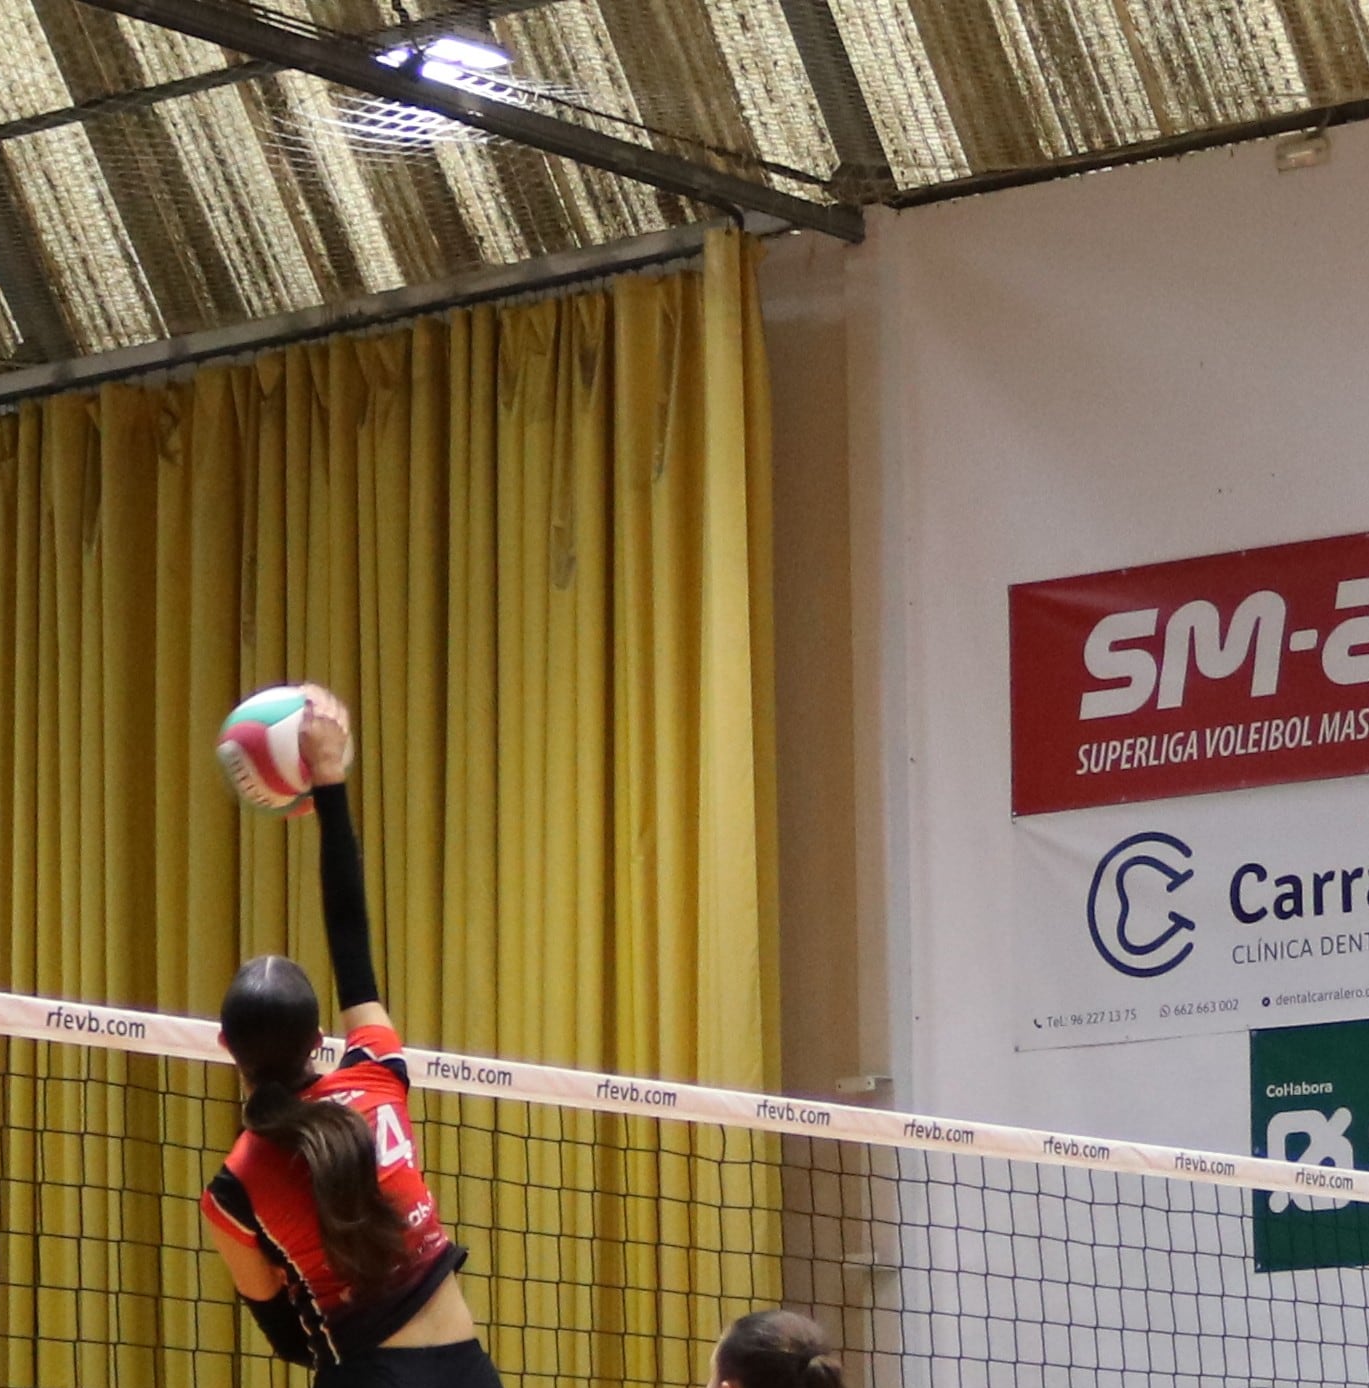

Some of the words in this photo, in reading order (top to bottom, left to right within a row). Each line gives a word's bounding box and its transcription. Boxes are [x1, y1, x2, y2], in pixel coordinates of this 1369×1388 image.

[1076, 730, 1199, 776] SUPERLIGA
[1205, 714, 1313, 759] VOLEIBOL
[1231, 937, 1313, 965] CLÍNICA
[1070, 1014, 1083, 1025] 96
[1086, 1011, 1105, 1024] 227
[1109, 1010, 1121, 1022] 13
[1125, 1008, 1137, 1021] 75
[1174, 1004, 1193, 1016] 662
[1196, 1001, 1216, 1014] 663
[1219, 999, 1239, 1012] 002
[46, 1006, 146, 1040] rfevb.com
[426, 1056, 513, 1087] rfevb.com
[596, 1082, 677, 1107] rfevb.com
[756, 1098, 831, 1127] rfevb.com
[376, 1104, 413, 1167] 4
[903, 1118, 975, 1144] rfevb.com
[1043, 1135, 1110, 1160] rfevb.com
[1174, 1151, 1235, 1176] rfevb.com
[1295, 1168, 1354, 1191] rfevb.com
